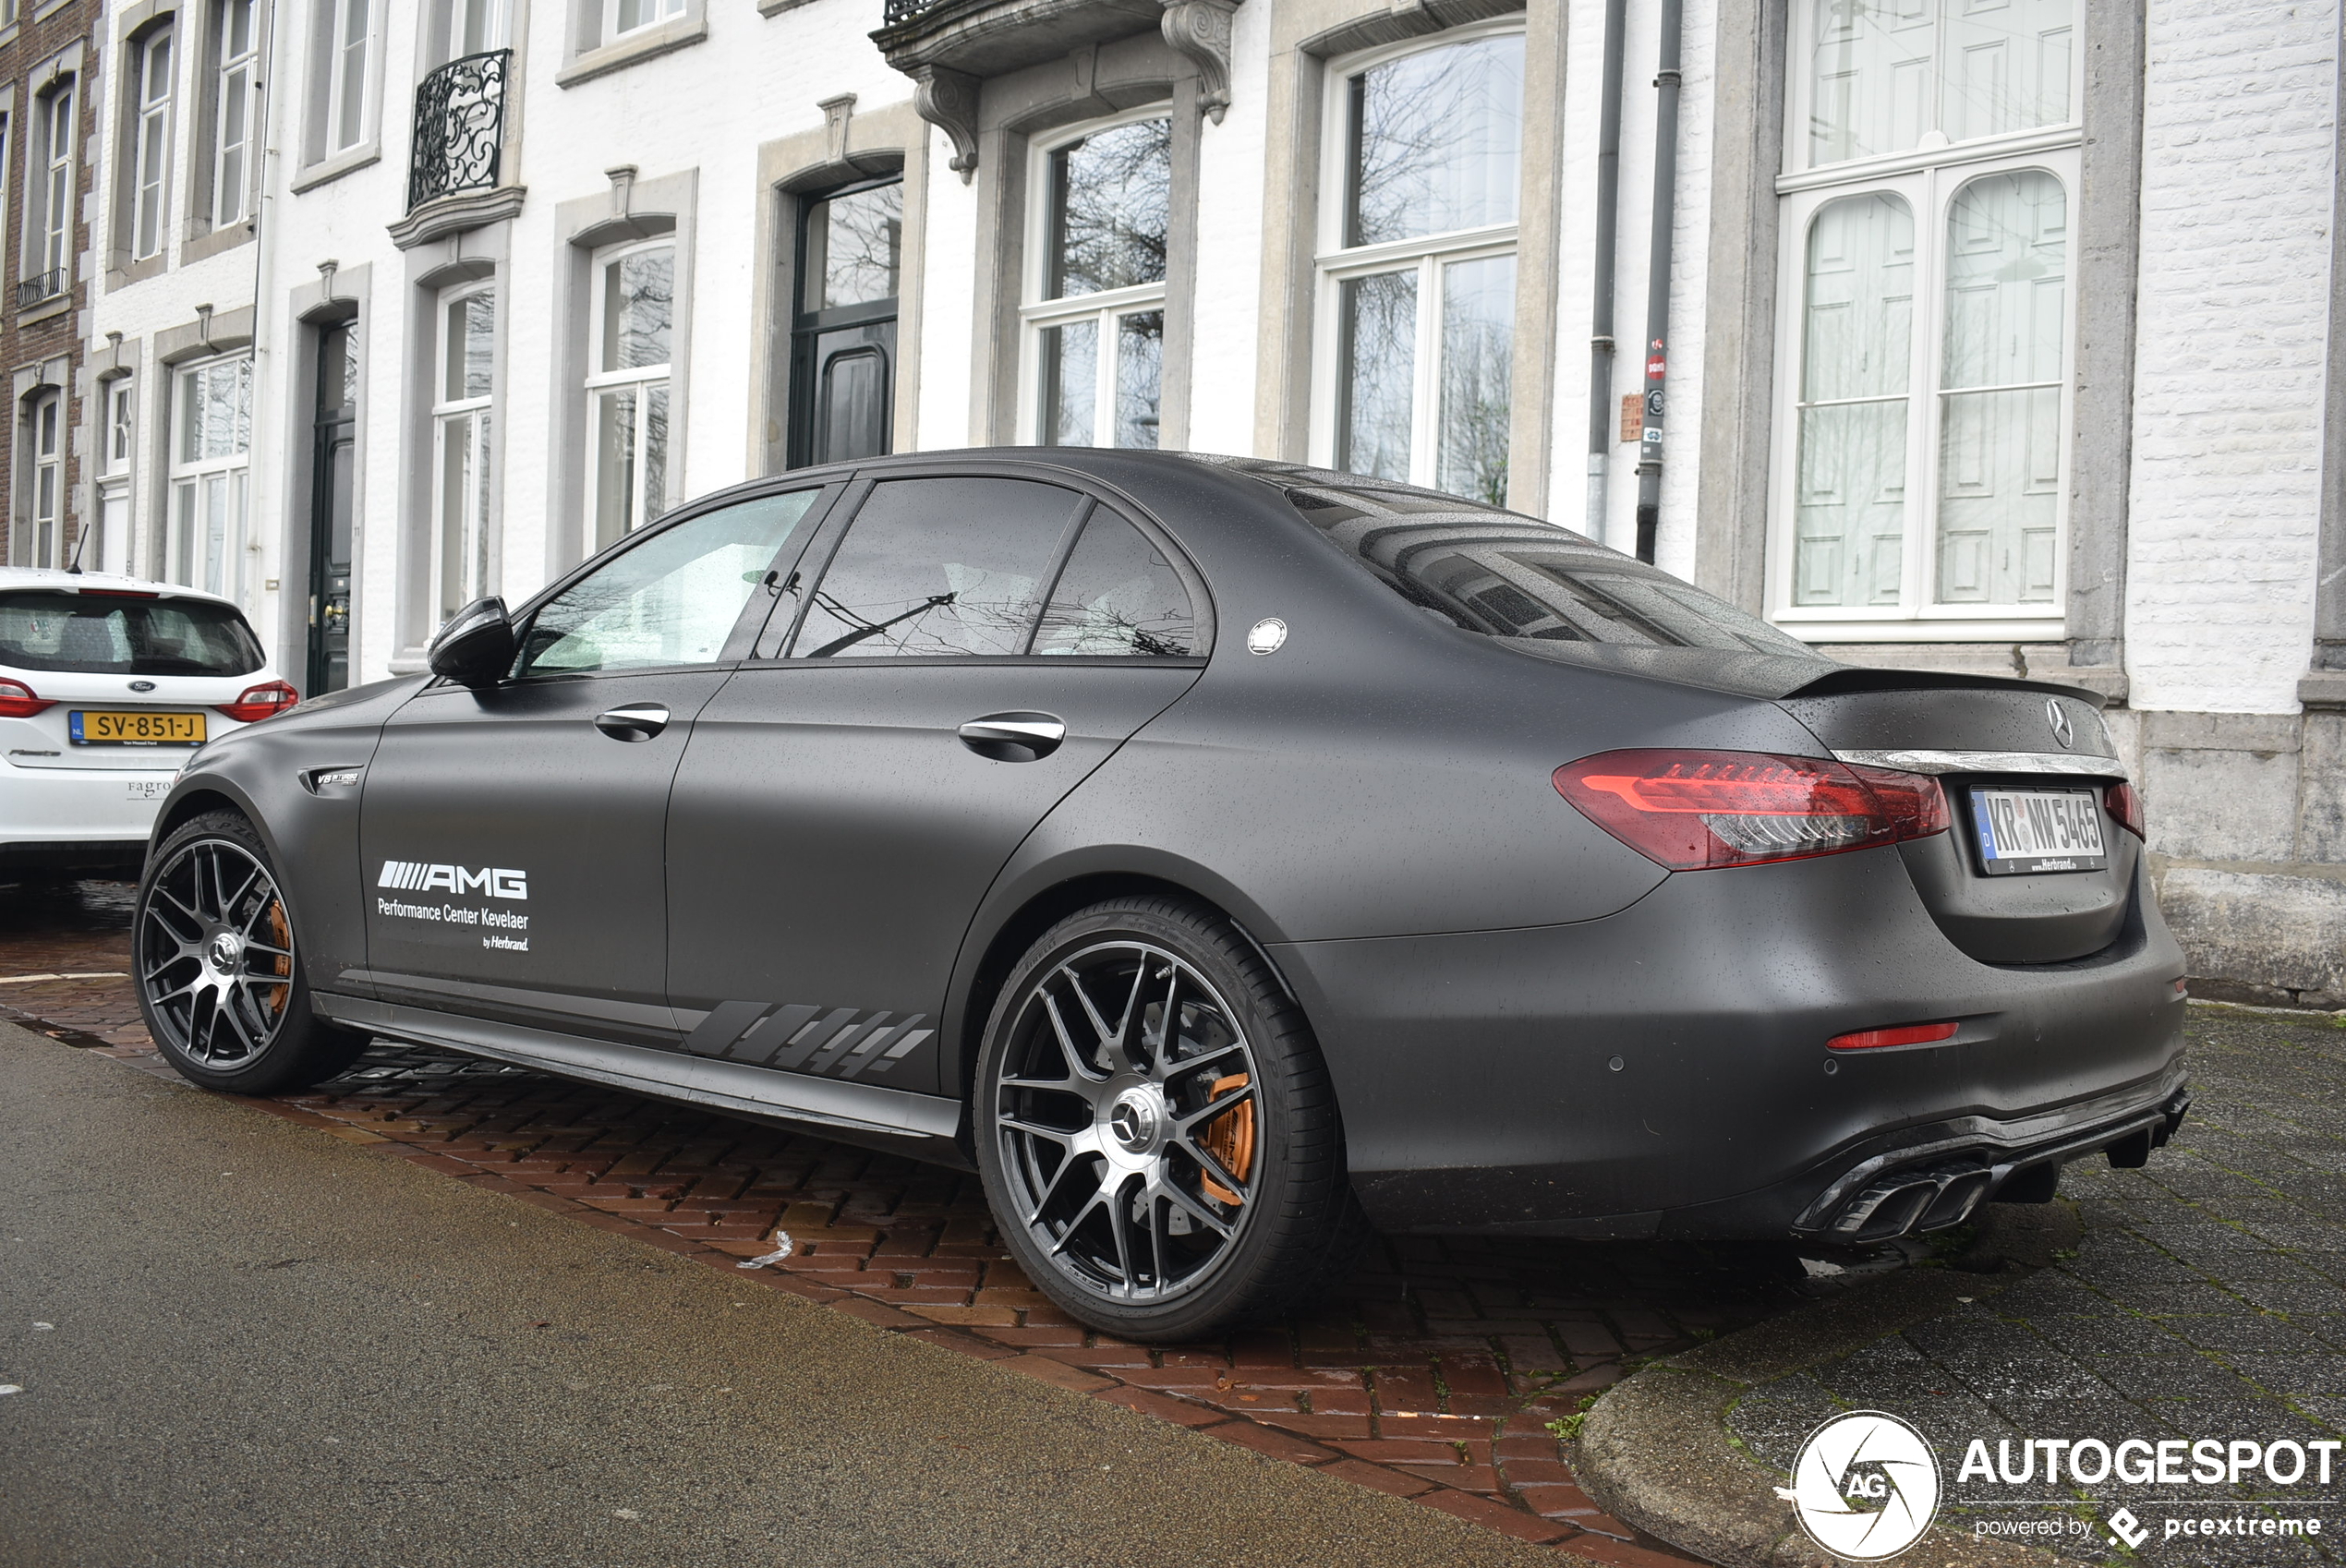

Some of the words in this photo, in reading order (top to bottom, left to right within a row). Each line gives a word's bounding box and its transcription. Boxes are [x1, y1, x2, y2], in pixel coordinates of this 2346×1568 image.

[73, 728, 83, 736] NL
[97, 716, 194, 737] SV-851-J
[318, 775, 333, 784] V8
[127, 781, 171, 798] Fagro
[1988, 798, 2022, 851] KR
[2051, 799, 2099, 850] 5465
[1982, 832, 1990, 847] D
[2031, 857, 2077, 872] www.Herbrand.de
[421, 863, 527, 900] AMG
[378, 898, 441, 921] Performance
[443, 904, 478, 925] Center
[481, 908, 529, 930] Kevelaer
[483, 936, 490, 949] by
